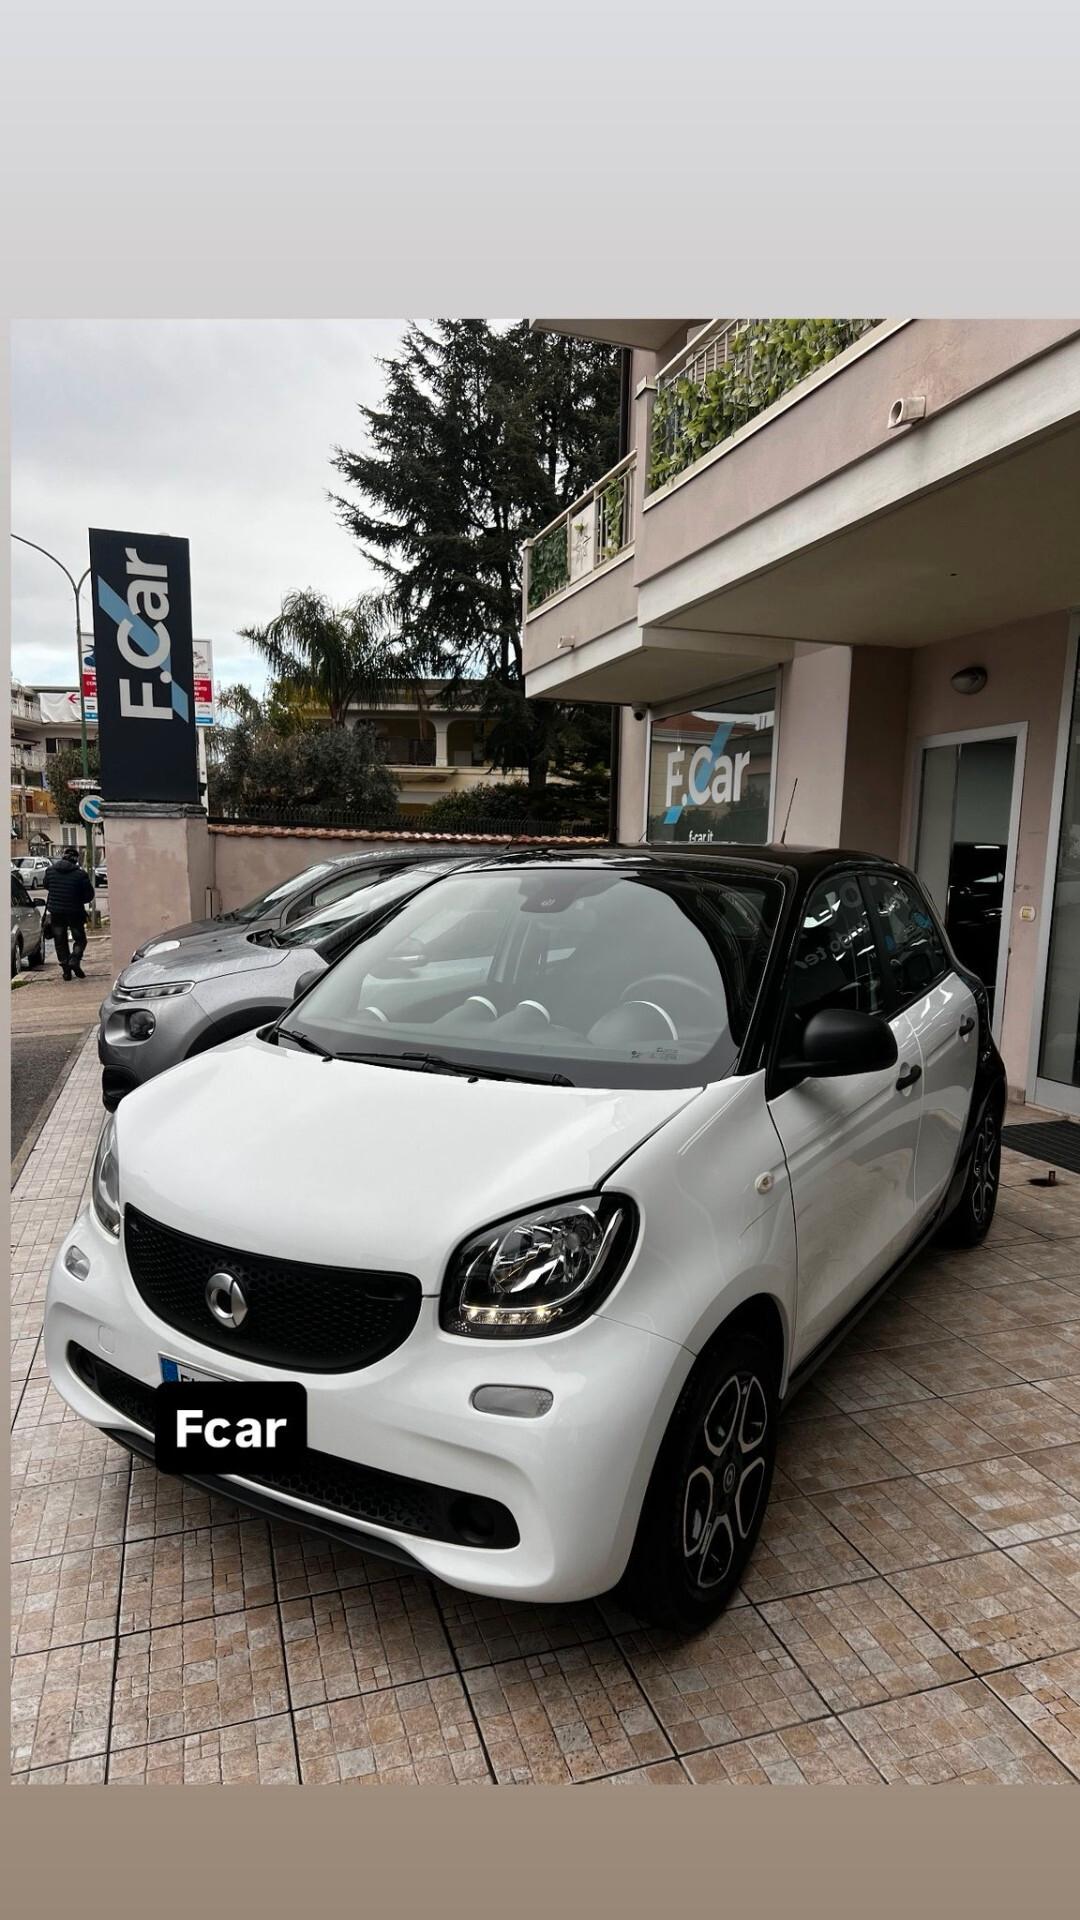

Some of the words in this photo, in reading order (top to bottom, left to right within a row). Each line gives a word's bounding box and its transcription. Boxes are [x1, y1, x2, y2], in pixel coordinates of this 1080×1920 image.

[117, 547, 173, 719] F.Car
[665, 746, 750, 807] F.Car
[689, 829, 714, 842] f-carit
